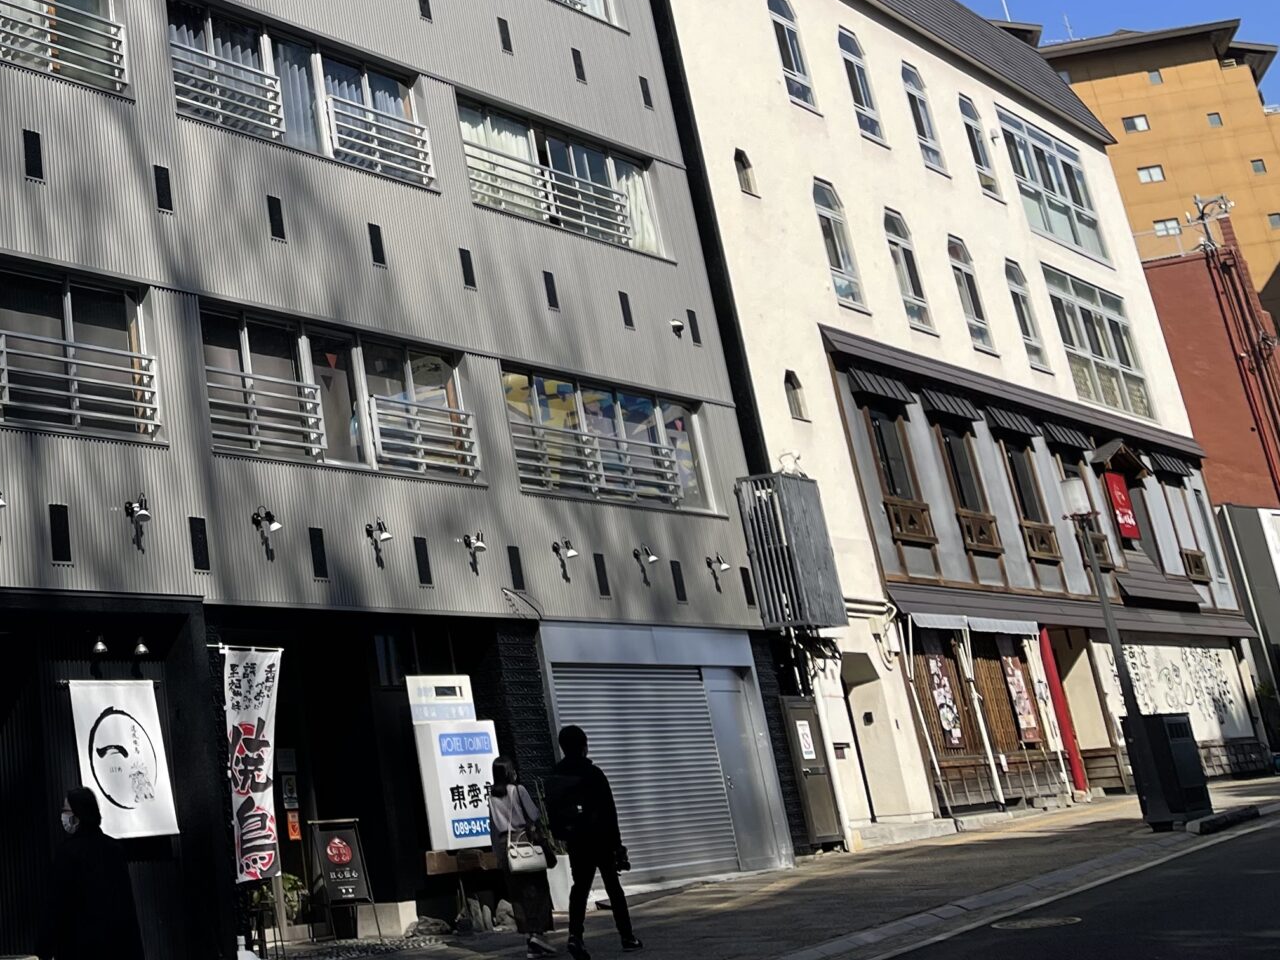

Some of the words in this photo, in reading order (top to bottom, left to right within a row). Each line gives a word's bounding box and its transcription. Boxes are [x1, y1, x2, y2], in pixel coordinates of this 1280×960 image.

[440, 737, 465, 753] HOTEL
[458, 762, 482, 775] ホテル
[228, 717, 282, 879] 焼鳥
